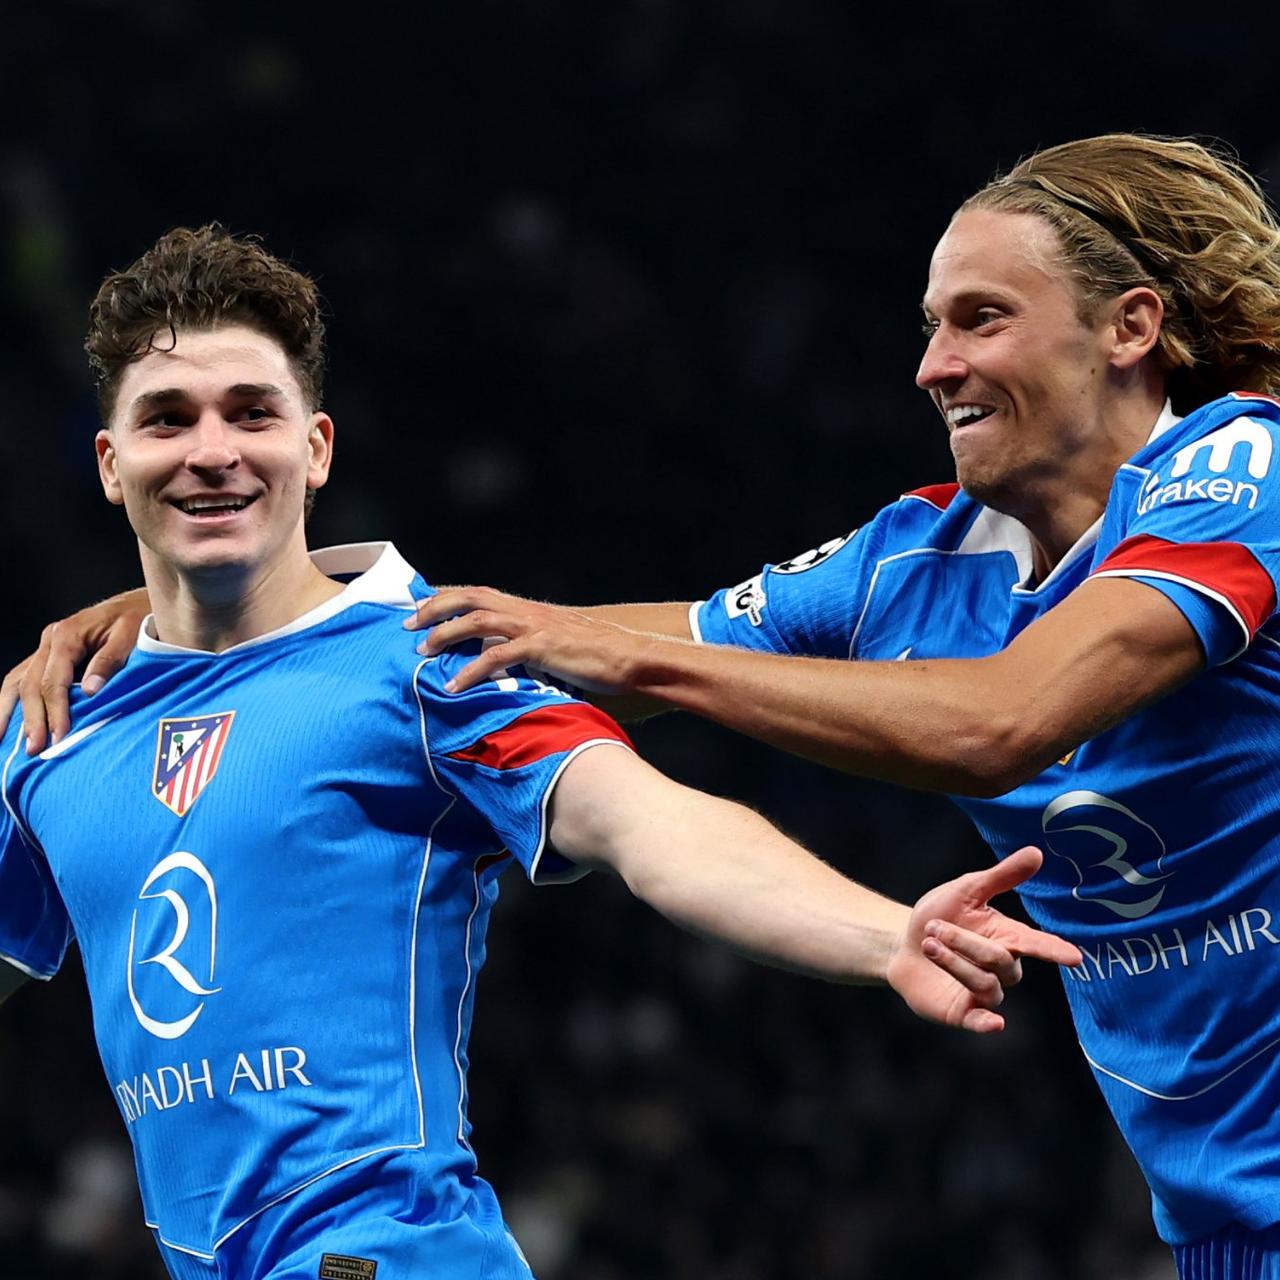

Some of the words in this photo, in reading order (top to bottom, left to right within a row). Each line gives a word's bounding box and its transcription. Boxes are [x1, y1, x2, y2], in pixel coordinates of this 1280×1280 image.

[1202, 908, 1280, 962] AIR
[115, 1058, 215, 1125] RIYADH
[228, 1046, 313, 1096] AIR
